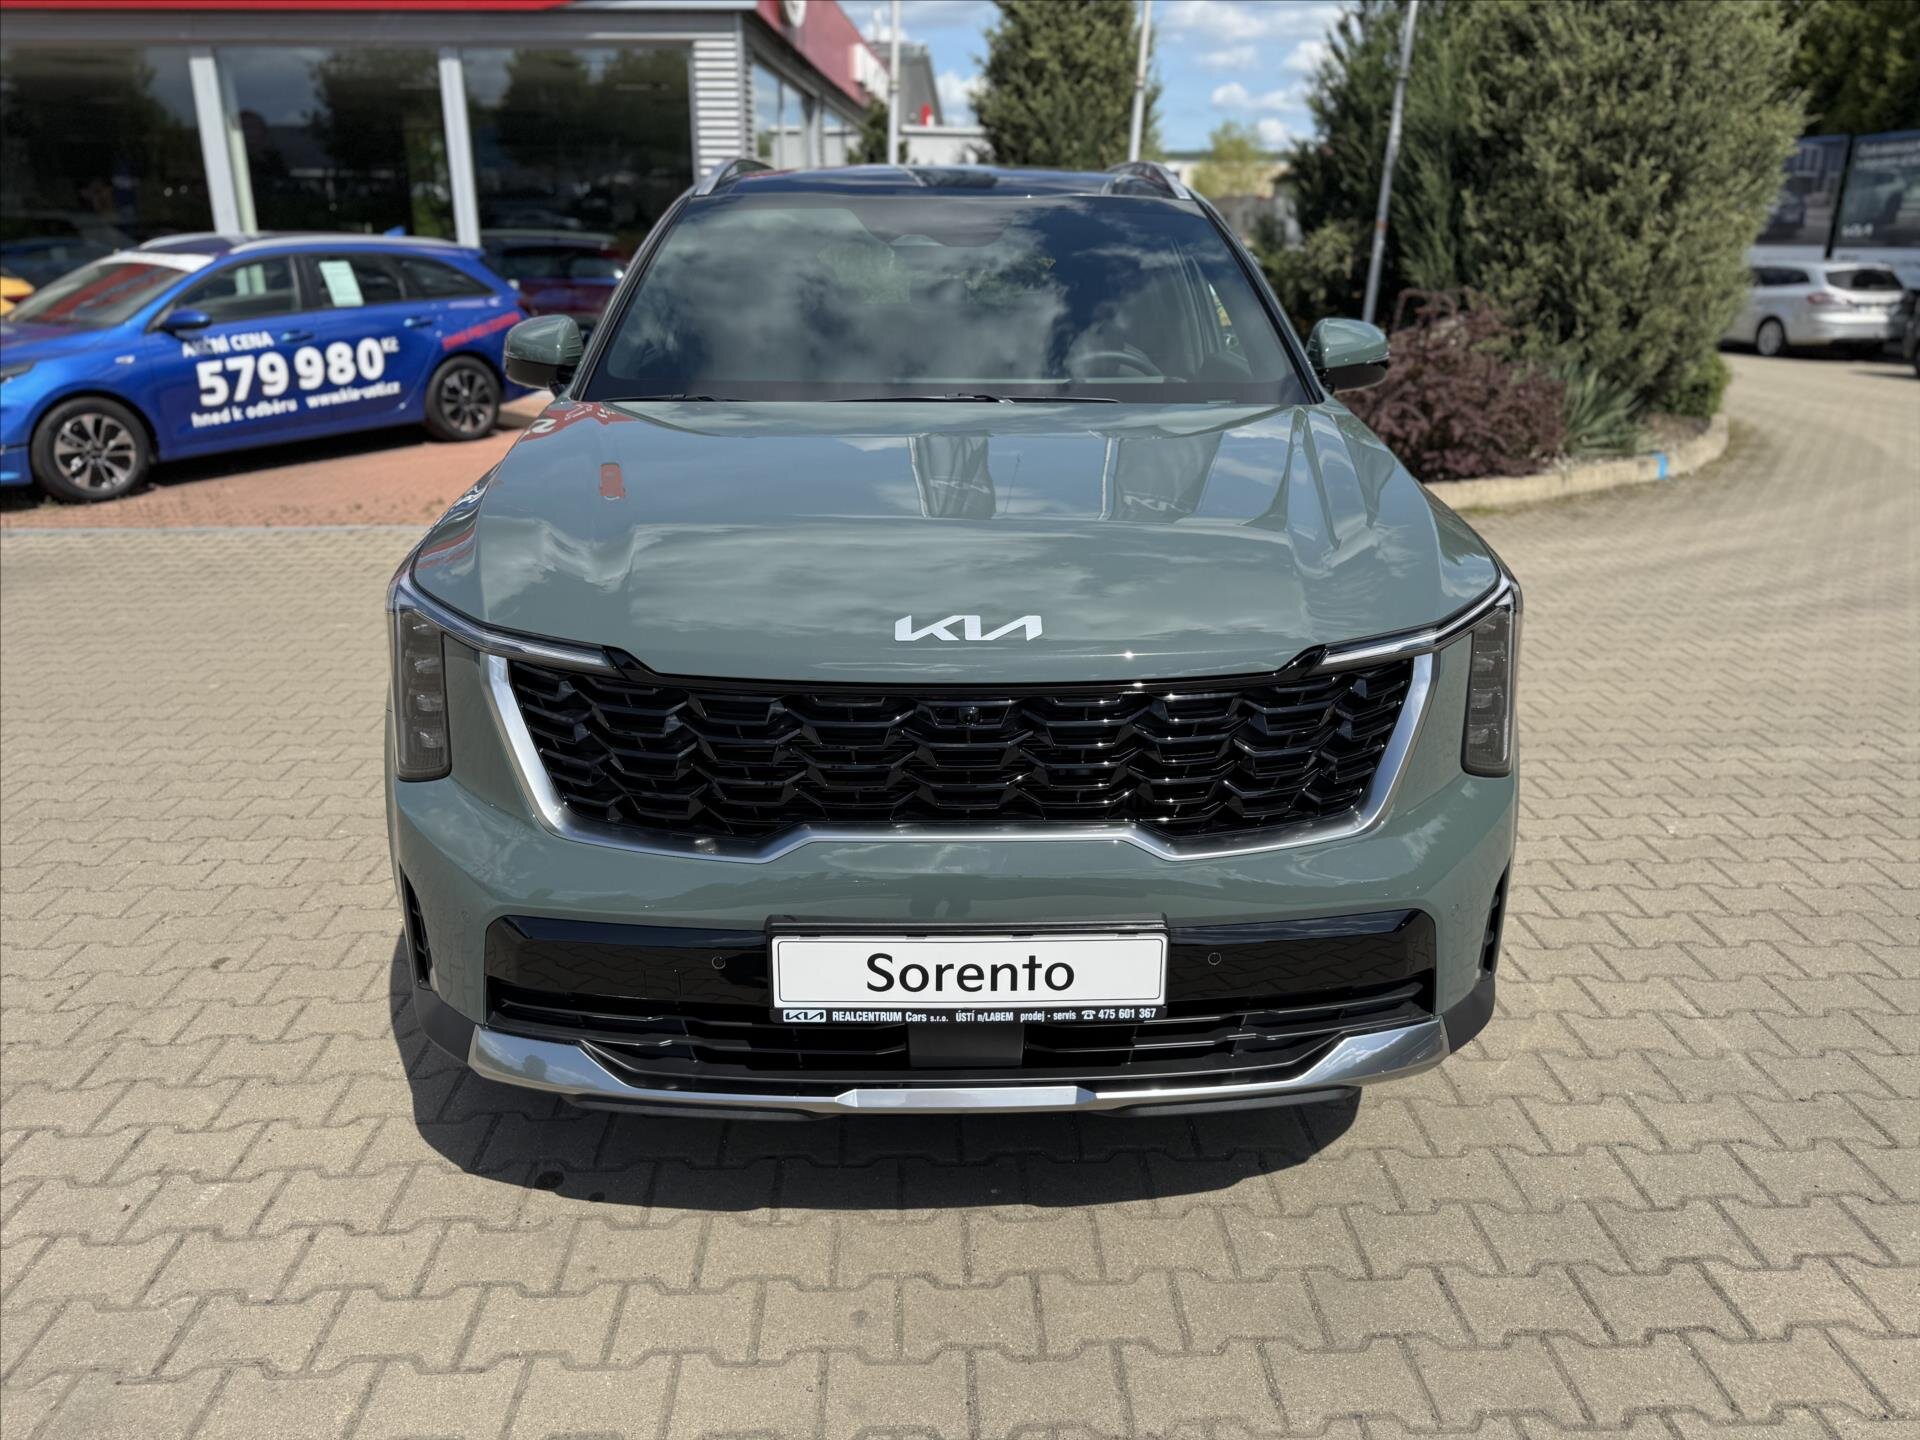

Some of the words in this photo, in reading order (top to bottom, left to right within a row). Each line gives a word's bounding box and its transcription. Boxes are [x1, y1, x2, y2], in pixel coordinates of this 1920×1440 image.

[230, 330, 275, 352] CENA
[196, 351, 289, 407] 579
[294, 337, 385, 390] 980
[191, 407, 232, 428] hned
[232, 405, 244, 421] k
[895, 615, 1043, 641] KIA
[866, 952, 1075, 993] Sorento
[784, 1010, 826, 1022] KIA
[832, 1011, 902, 1022] REALCENTRUM
[906, 1011, 926, 1022] Cars
[930, 1014, 948, 1022] s.r.o.
[955, 1009, 975, 1022] ÚSTÍ
[977, 1011, 1013, 1023] n/LABEM
[1020, 1010, 1045, 1023] prodej
[1053, 1010, 1076, 1021] servis
[1098, 1008, 1115, 1019] 475
[1118, 1008, 1135, 1019] 601
[1138, 1008, 1156, 1019] 367
